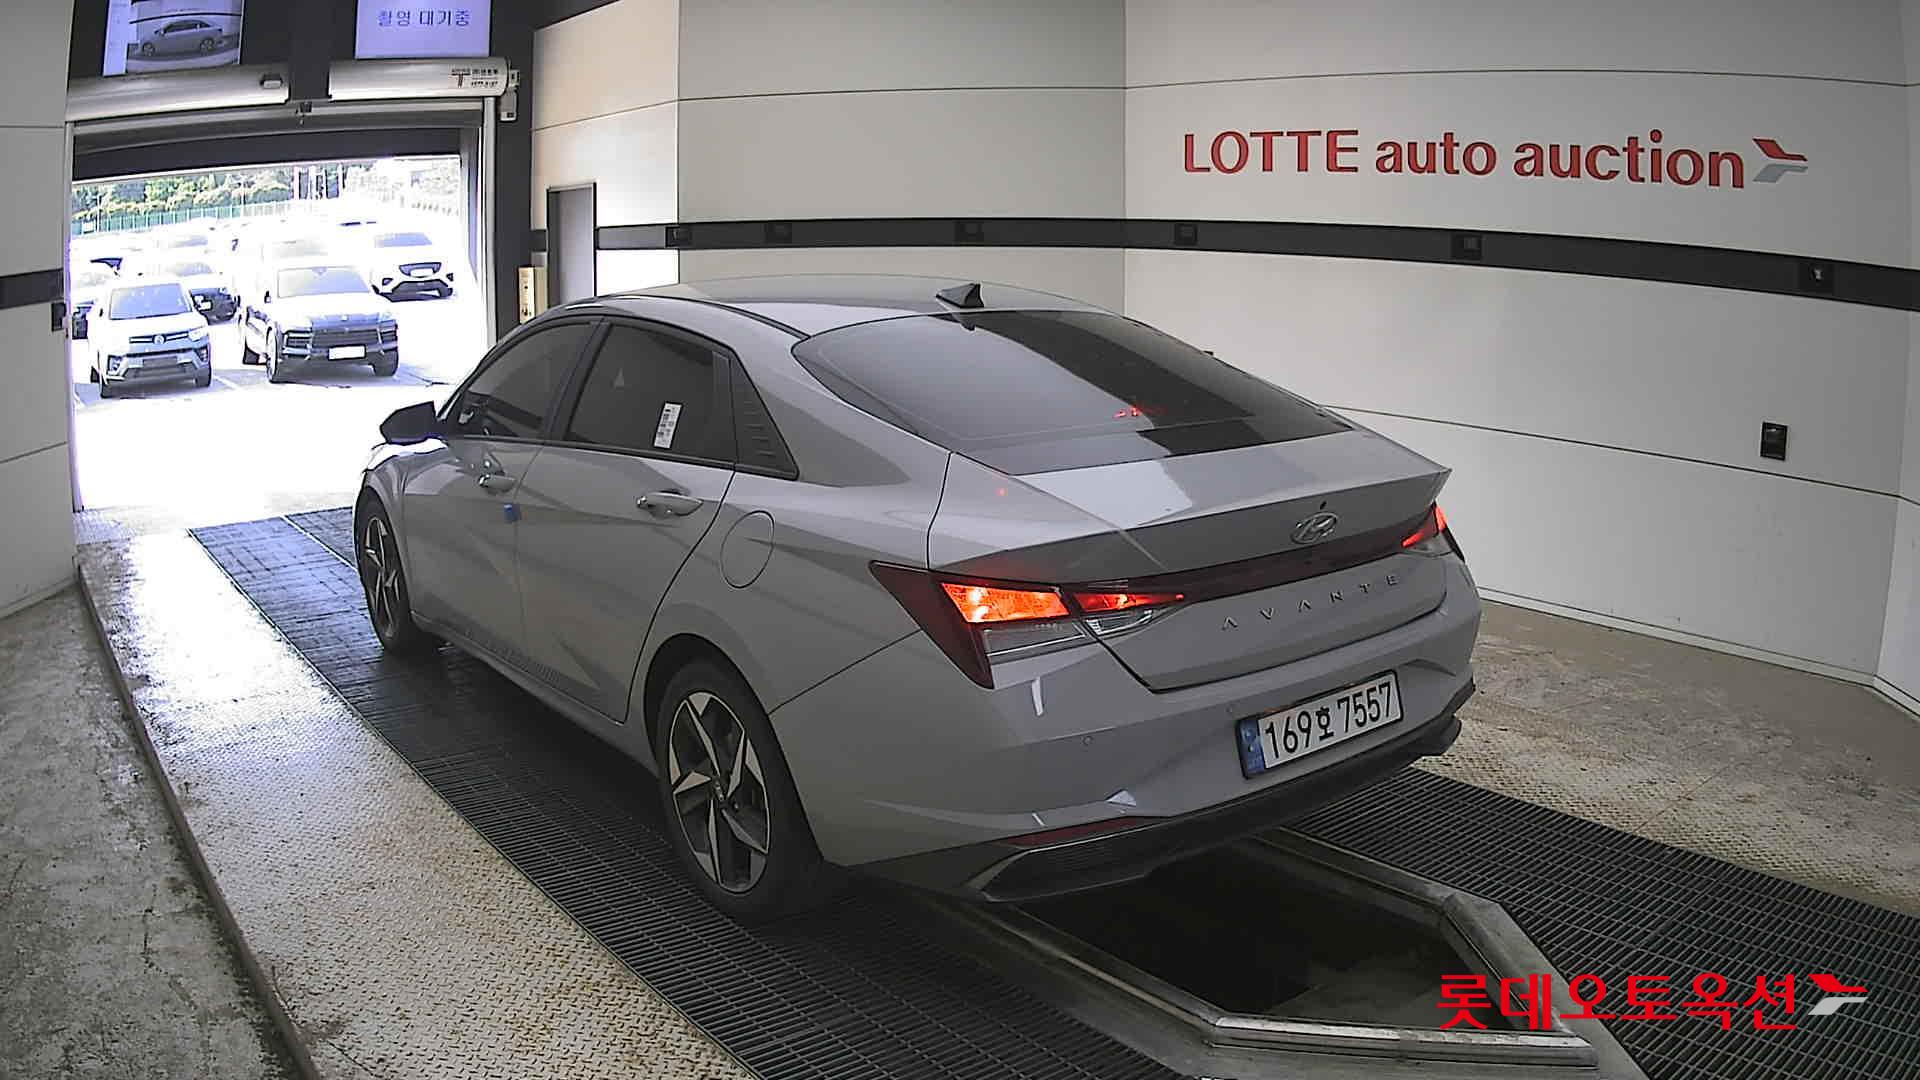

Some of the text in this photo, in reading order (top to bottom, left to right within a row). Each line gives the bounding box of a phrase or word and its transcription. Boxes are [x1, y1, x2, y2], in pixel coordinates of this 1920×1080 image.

[419, 9, 470, 26] 대기중
[1184, 129, 1745, 189] LOTTE auto auction
[1222, 575, 1399, 631] AVANTE
[1336, 681, 1392, 733] 7557
